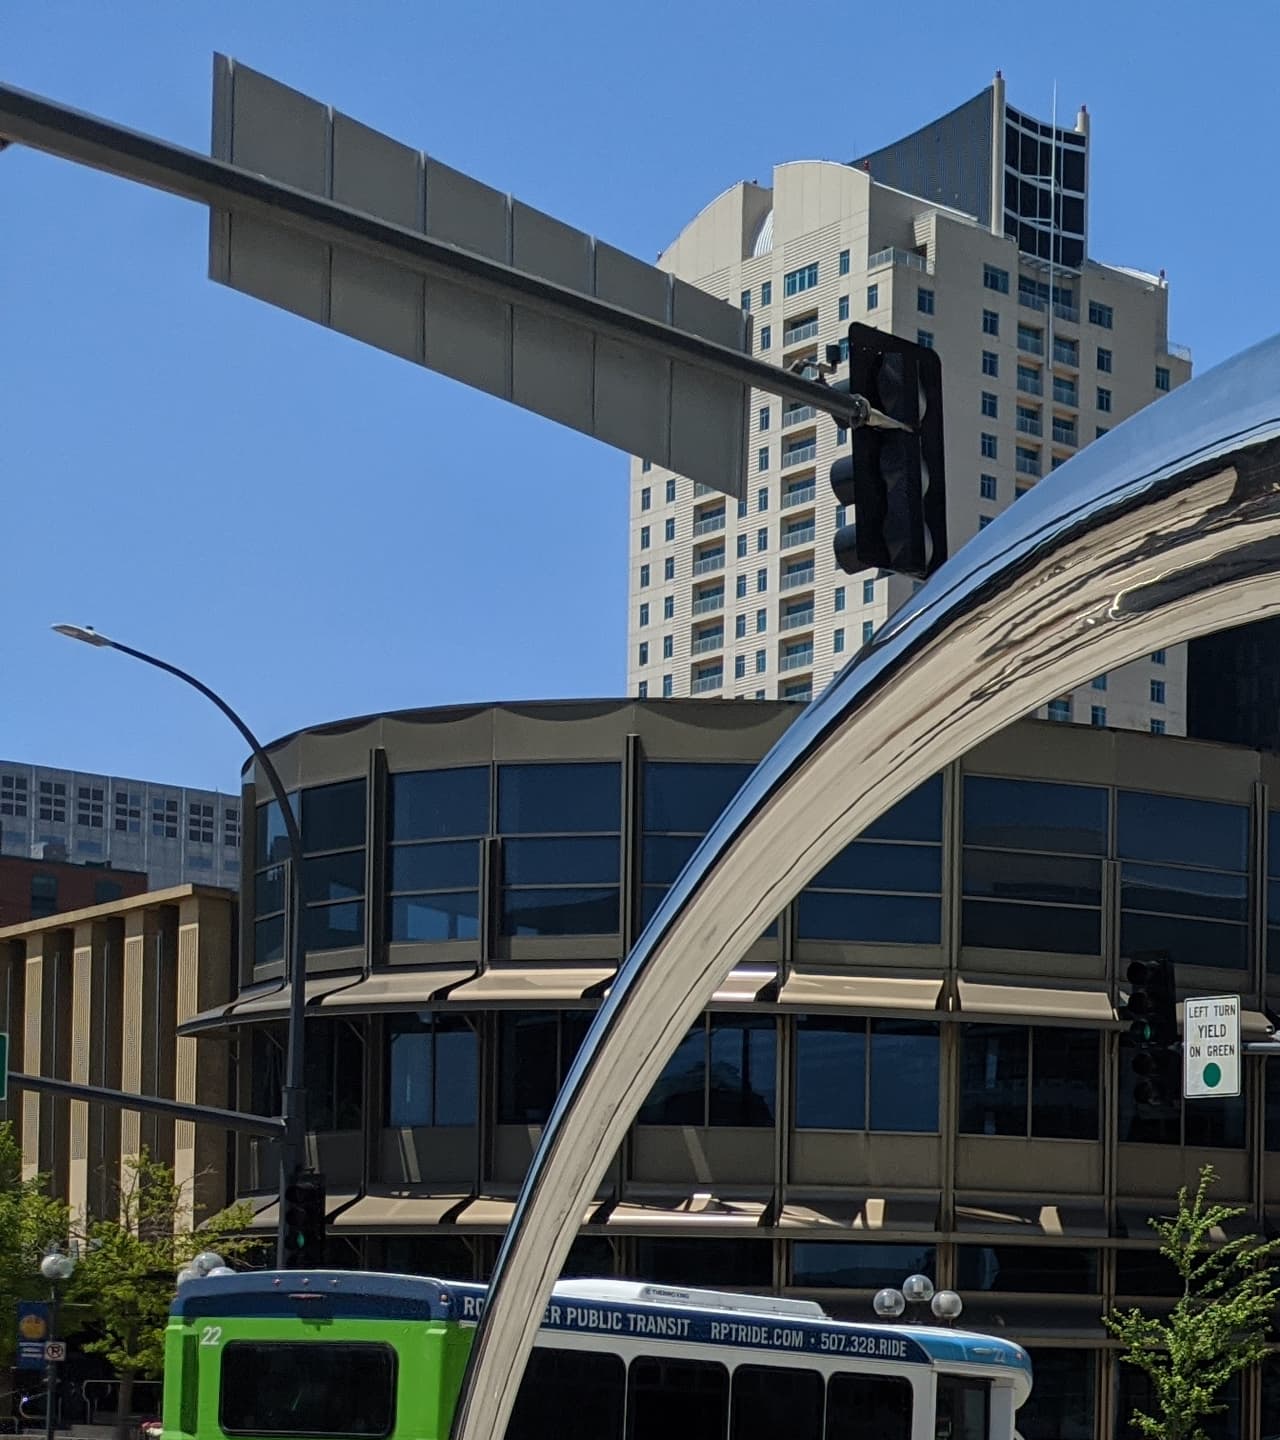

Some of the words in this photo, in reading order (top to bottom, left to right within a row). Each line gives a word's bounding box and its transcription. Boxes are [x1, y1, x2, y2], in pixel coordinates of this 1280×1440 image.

[1188, 1006, 1209, 1019] LEFT
[1213, 1004, 1236, 1017] TURN
[1198, 1024, 1227, 1039] YIELD
[1189, 1046, 1201, 1058] ON
[1207, 1044, 1235, 1057] GREEN
[201, 1326, 222, 1345] 22
[565, 1307, 622, 1329] PUBLIC
[627, 1313, 690, 1336] TRANSIT
[710, 1321, 803, 1347] RPTRIDE.COM
[820, 1332, 907, 1357] 507.328.RIDE
